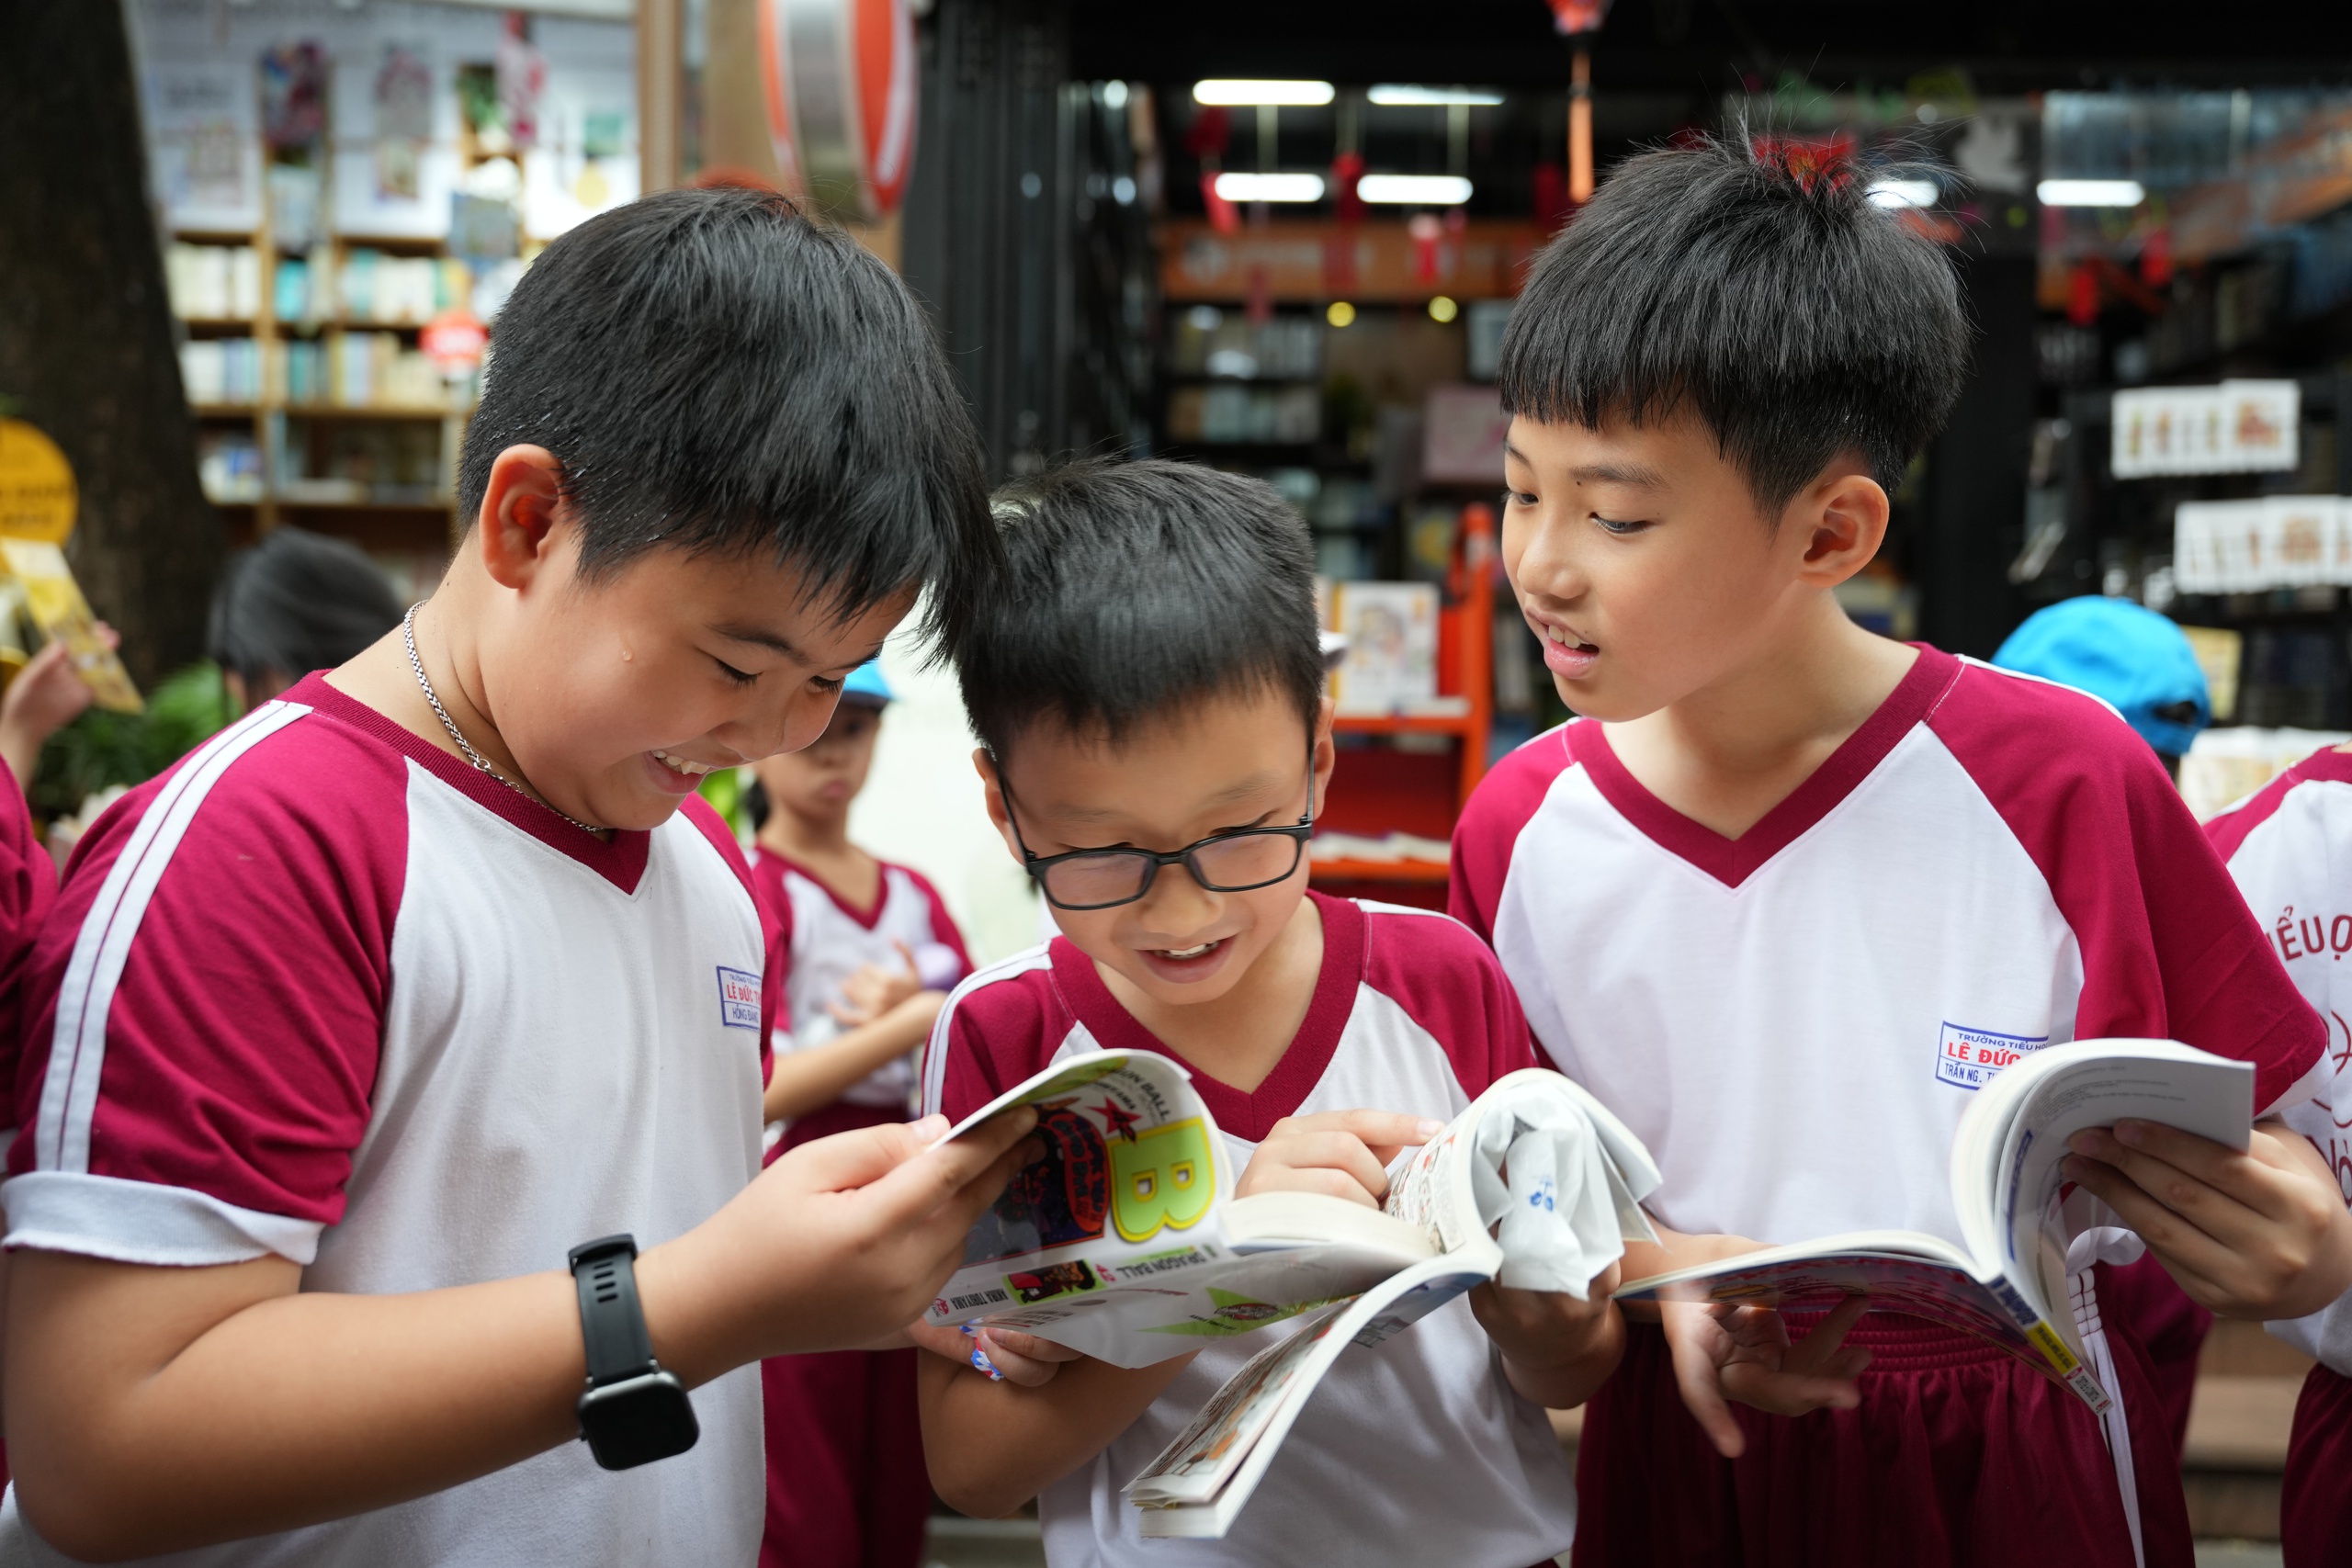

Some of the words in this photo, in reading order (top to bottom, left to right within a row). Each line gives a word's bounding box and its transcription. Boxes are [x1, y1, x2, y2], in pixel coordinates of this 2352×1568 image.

[727, 982, 737, 999] LÊ
[739, 985, 753, 1003] ĐỨC
[1958, 1032, 2006, 1047] TRƯỜNG
[2008, 1040, 2033, 1051] TIỂU
[1948, 1042, 1971, 1061] LÊ
[1967, 1068, 1983, 1083] NG.
[1115, 1262, 1155, 1279] BALL
[950, 1292, 989, 1311] TORIYAMA
[984, 1288, 1009, 1303] AKIRA
